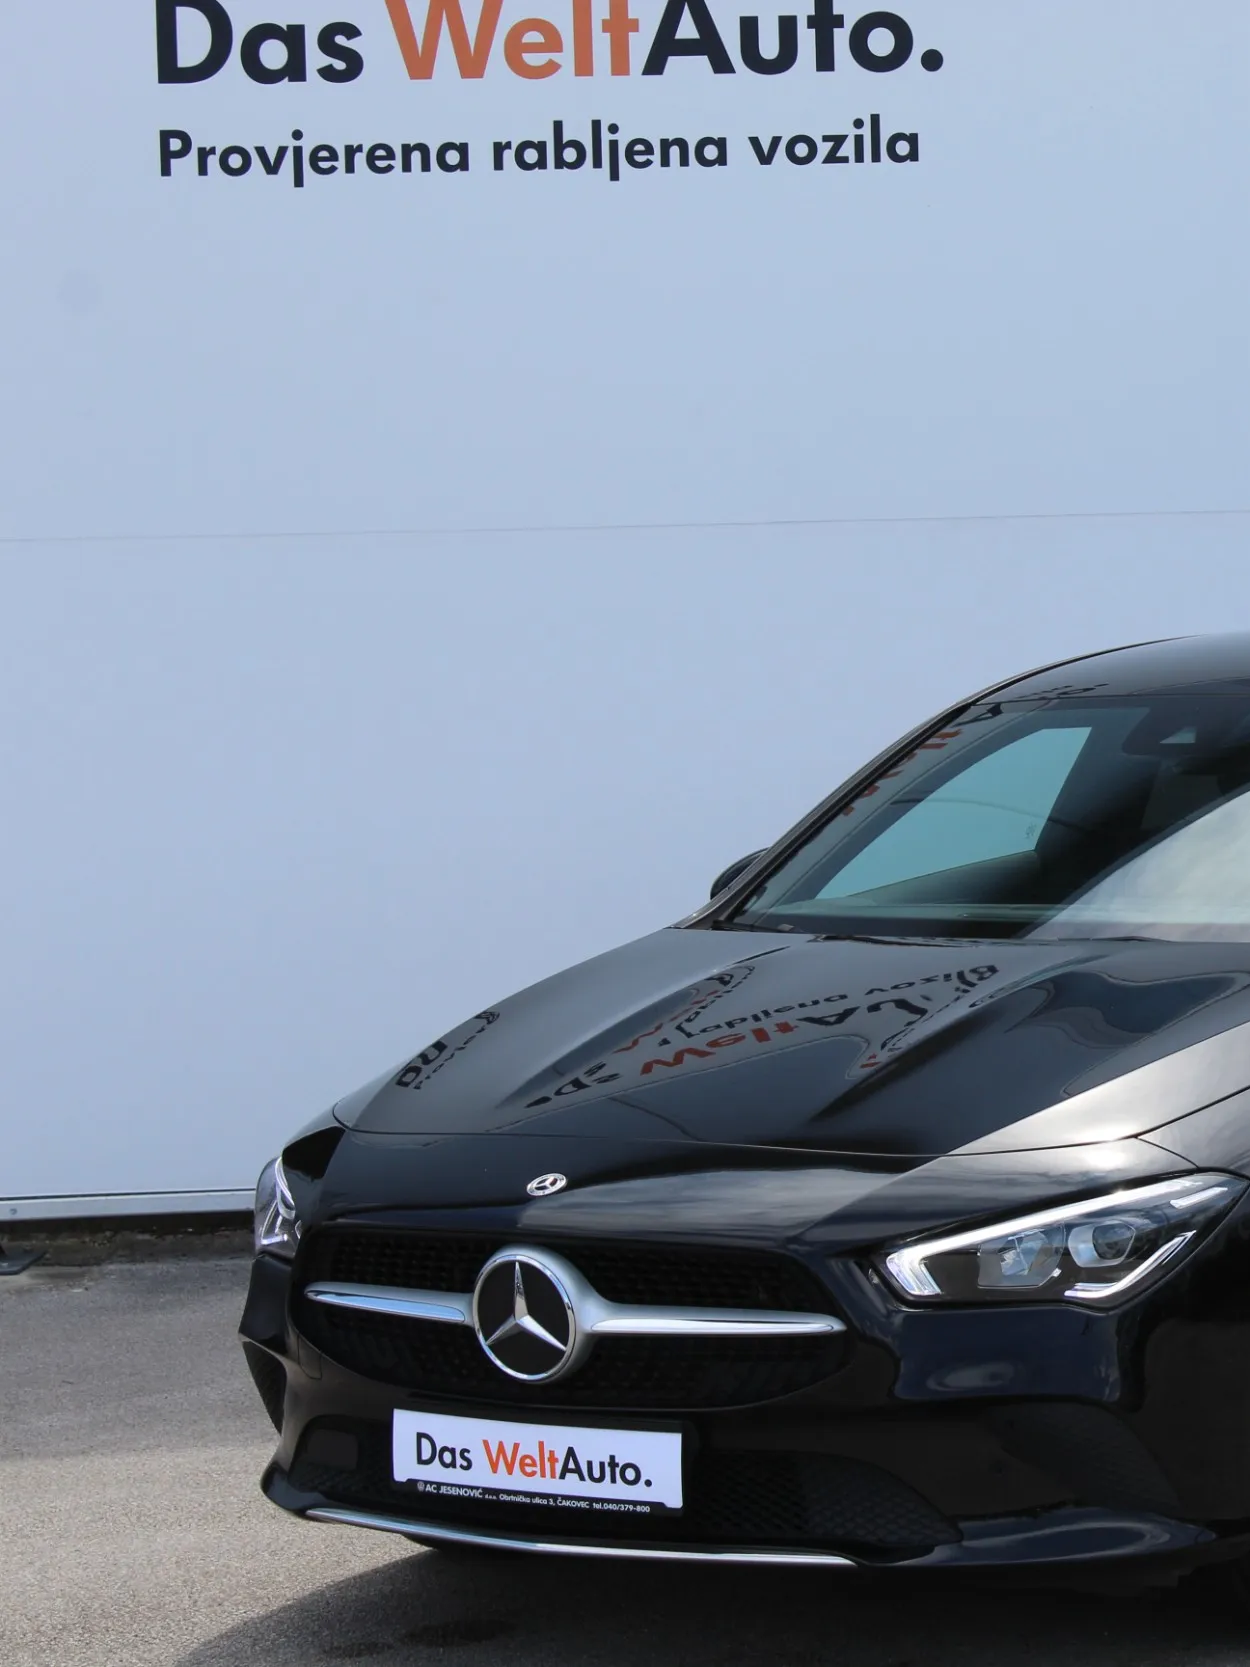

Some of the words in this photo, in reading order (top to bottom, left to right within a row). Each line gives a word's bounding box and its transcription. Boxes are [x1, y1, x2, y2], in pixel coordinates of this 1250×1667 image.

[156, 0, 363, 84] Das
[385, 0, 944, 80] WeltAuto.
[160, 129, 469, 188] Provjerena
[492, 120, 728, 182] rabljena
[748, 114, 919, 166] vozila
[416, 1431, 473, 1471] Das
[482, 1439, 652, 1488] WeltAuto.
[425, 1484, 437, 1493] AC
[439, 1486, 483, 1499] JESENOVIĆ
[532, 1497, 548, 1505] ulica
[557, 1497, 590, 1509] ČAKOVEC
